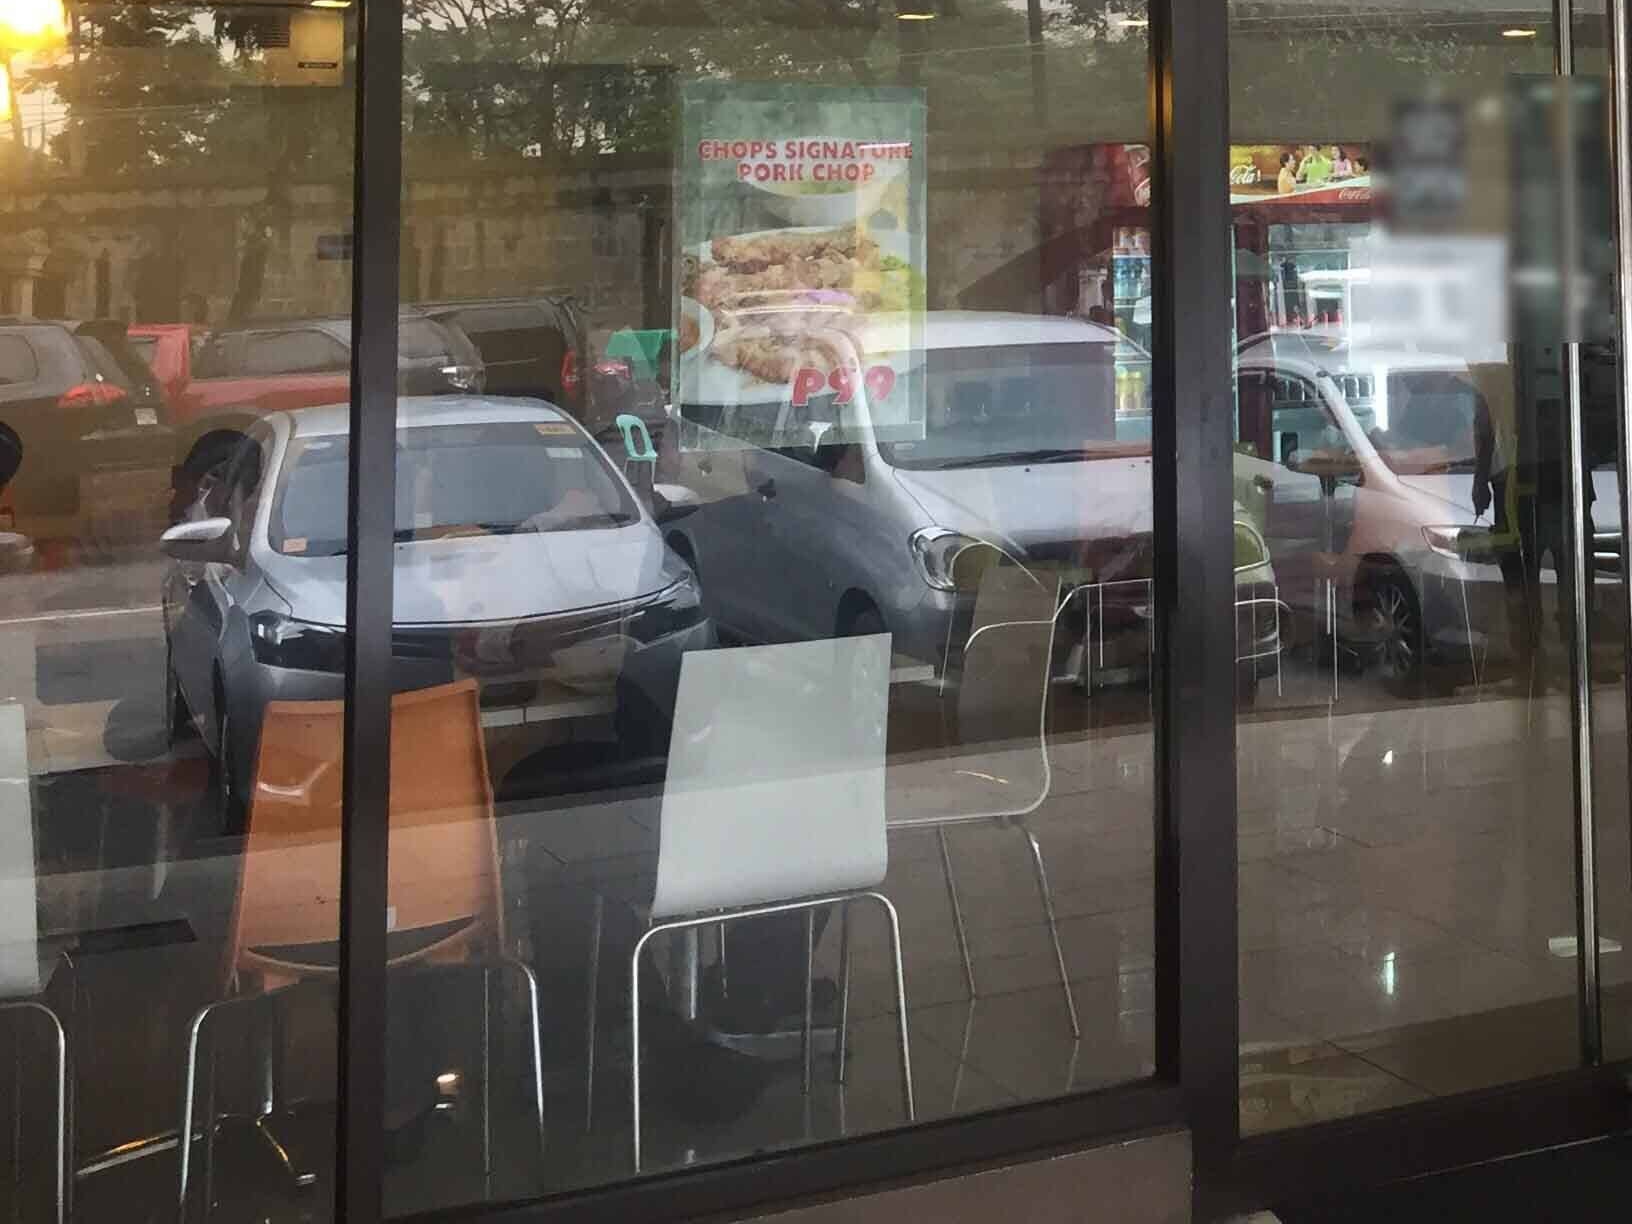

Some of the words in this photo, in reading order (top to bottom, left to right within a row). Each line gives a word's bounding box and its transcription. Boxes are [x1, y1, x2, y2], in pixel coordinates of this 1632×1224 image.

[698, 141, 777, 159] CHOPS
[785, 141, 913, 159] SIGNATURE
[738, 163, 804, 181] PORK
[812, 163, 875, 181] CHOP
[792, 366, 896, 407] P99
